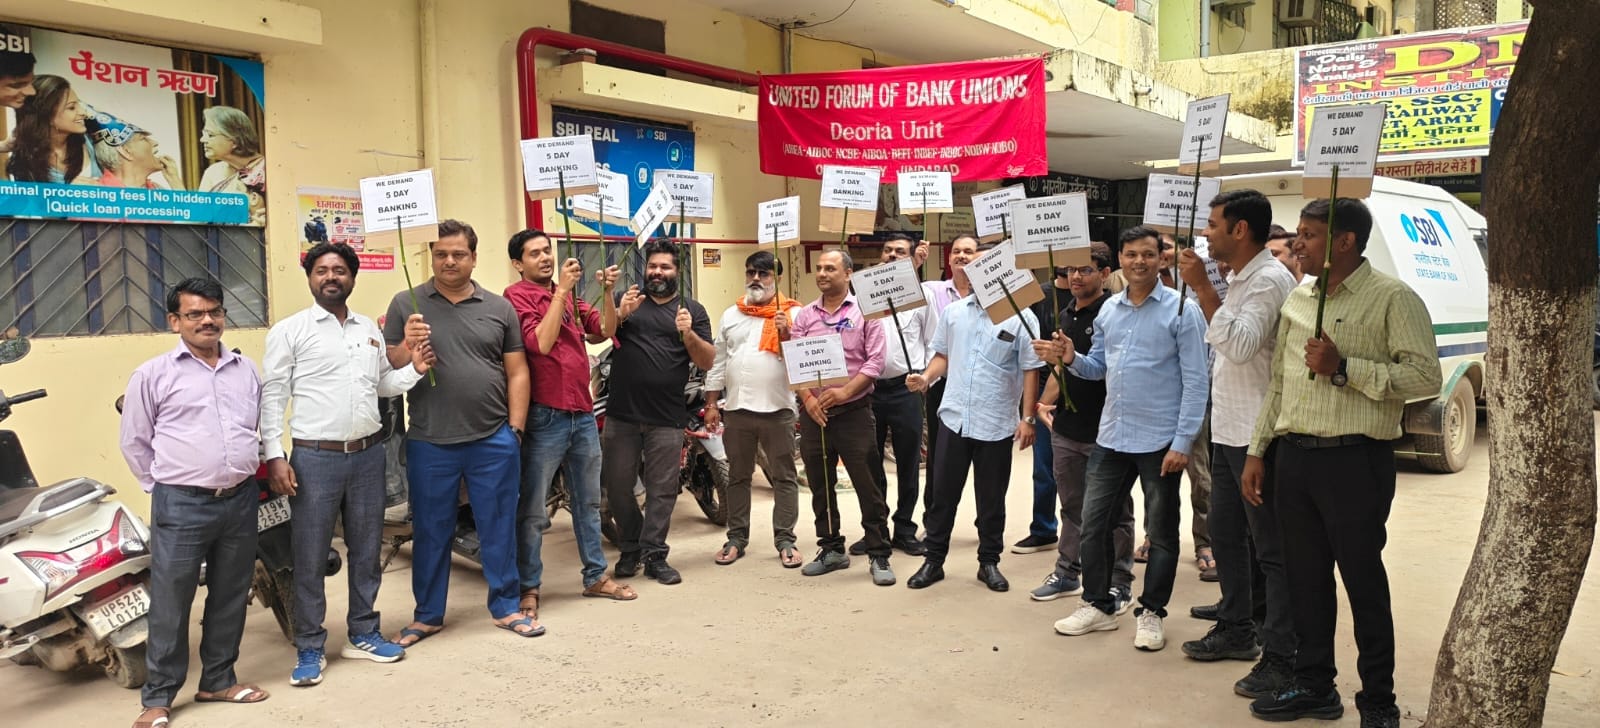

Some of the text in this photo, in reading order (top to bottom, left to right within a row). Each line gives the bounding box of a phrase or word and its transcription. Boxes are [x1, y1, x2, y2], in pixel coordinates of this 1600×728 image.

[1368, 43, 1378, 51] Sir
[1316, 52, 1366, 64] Daily
[1308, 59, 1378, 74] Notes &
[1306, 70, 1378, 82] Analysis
[156, 69, 217, 96] ऋण
[768, 74, 1028, 109] UNITED FORUM OF BANK UNIONS
[1411, 93, 1482, 106] SSC,
[1338, 110, 1363, 119] DEMAND
[1413, 114, 1478, 127] ARMY
[584, 126, 620, 142] REAL
[653, 130, 667, 140] SBI
[830, 120, 945, 141] Deoria Unit
[1332, 126, 1356, 136] 5 DAY
[554, 151, 570, 159] DAY
[1320, 145, 1359, 154] BANKING
[539, 164, 578, 173] BANKING
[388, 177, 413, 186] DEMAND
[43, 188, 116, 202] processing
[120, 190, 146, 201] fees
[173, 192, 211, 204] hidden
[215, 196, 244, 206] costs
[393, 189, 409, 197] DAY
[833, 188, 864, 196] BANKING
[1177, 190, 1194, 198] DAY
[671, 194, 699, 202] ANKING
[378, 202, 417, 213] BANKING
[996, 201, 1008, 210] DAY
[1038, 200, 1067, 208] DEMAND
[93, 203, 120, 214] loan
[124, 206, 191, 219] processing
[1043, 211, 1062, 220] DAY
[765, 220, 789, 229] BANKING
[1027, 224, 1070, 236] BANKING
[1413, 216, 1442, 247] SBI
[981, 249, 1002, 264] DEMAND
[989, 261, 1003, 273] DAY
[880, 276, 895, 285] DAY
[983, 269, 1014, 290] BANKING
[870, 285, 905, 299] BANKING
[799, 359, 832, 369] BANKING
[100, 591, 142, 617] UP52A
[107, 601, 148, 629] L0122
